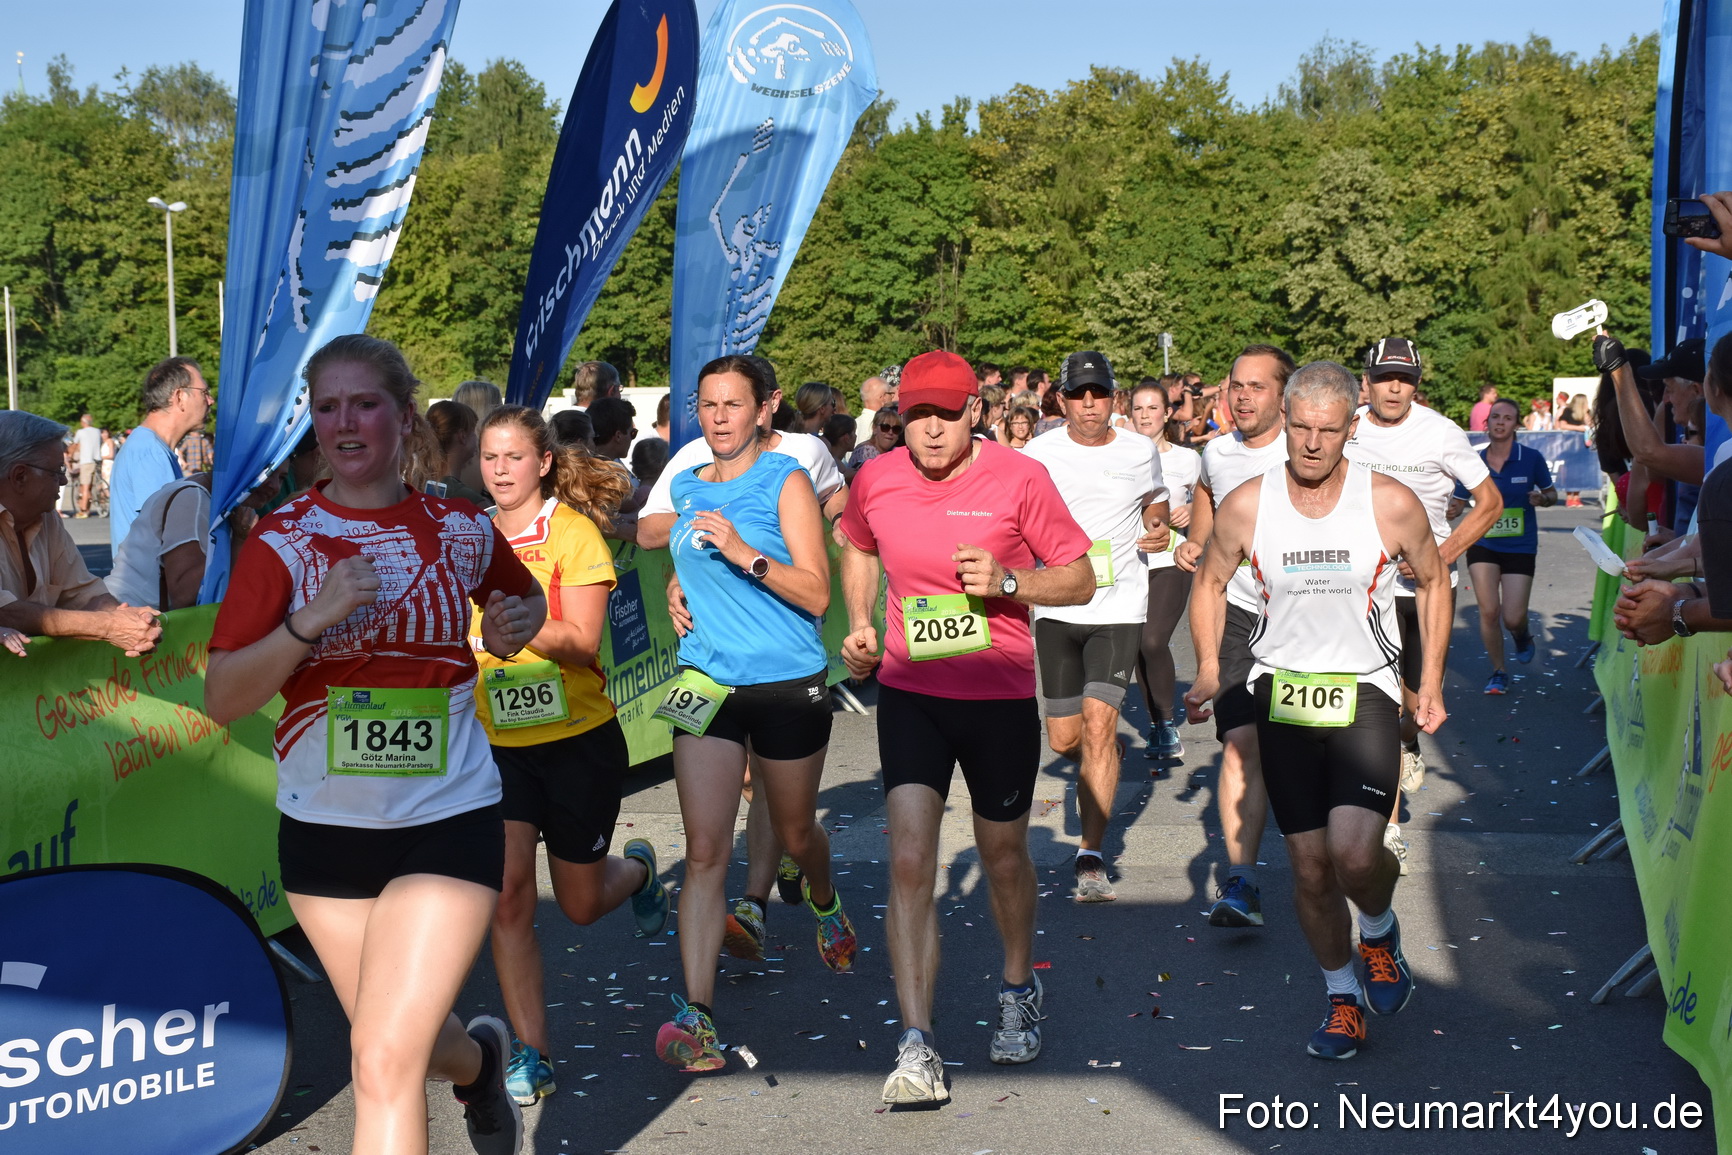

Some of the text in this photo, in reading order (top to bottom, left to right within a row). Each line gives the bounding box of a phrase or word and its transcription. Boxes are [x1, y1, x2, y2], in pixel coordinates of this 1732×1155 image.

[751, 61, 852, 99] WECHSELSZENE
[592, 86, 685, 261] Druck und Medien
[1386, 464, 1425, 473] HOLZBAU
[1282, 550, 1350, 566] HUBER
[1287, 587, 1352, 596] moves the world
[1305, 578, 1331, 586] Water
[614, 599, 638, 620] Fischer
[913, 615, 977, 643] 2082
[603, 637, 681, 708] irmenlau
[35, 657, 138, 740] Gesunde
[344, 701, 386, 710] firmenlauf
[494, 683, 553, 711] 1296
[667, 687, 710, 715] 197
[1280, 684, 1344, 710] 2106
[520, 708, 544, 716] Claudia
[344, 719, 433, 752] 1843
[104, 716, 182, 782] laufen
[361, 753, 416, 762] Götz Marina
[341, 761, 434, 770] Sparkasse Neumarkt-Parsberg
[1362, 784, 1387, 797] benger
[0, 1001, 230, 1088] scher
